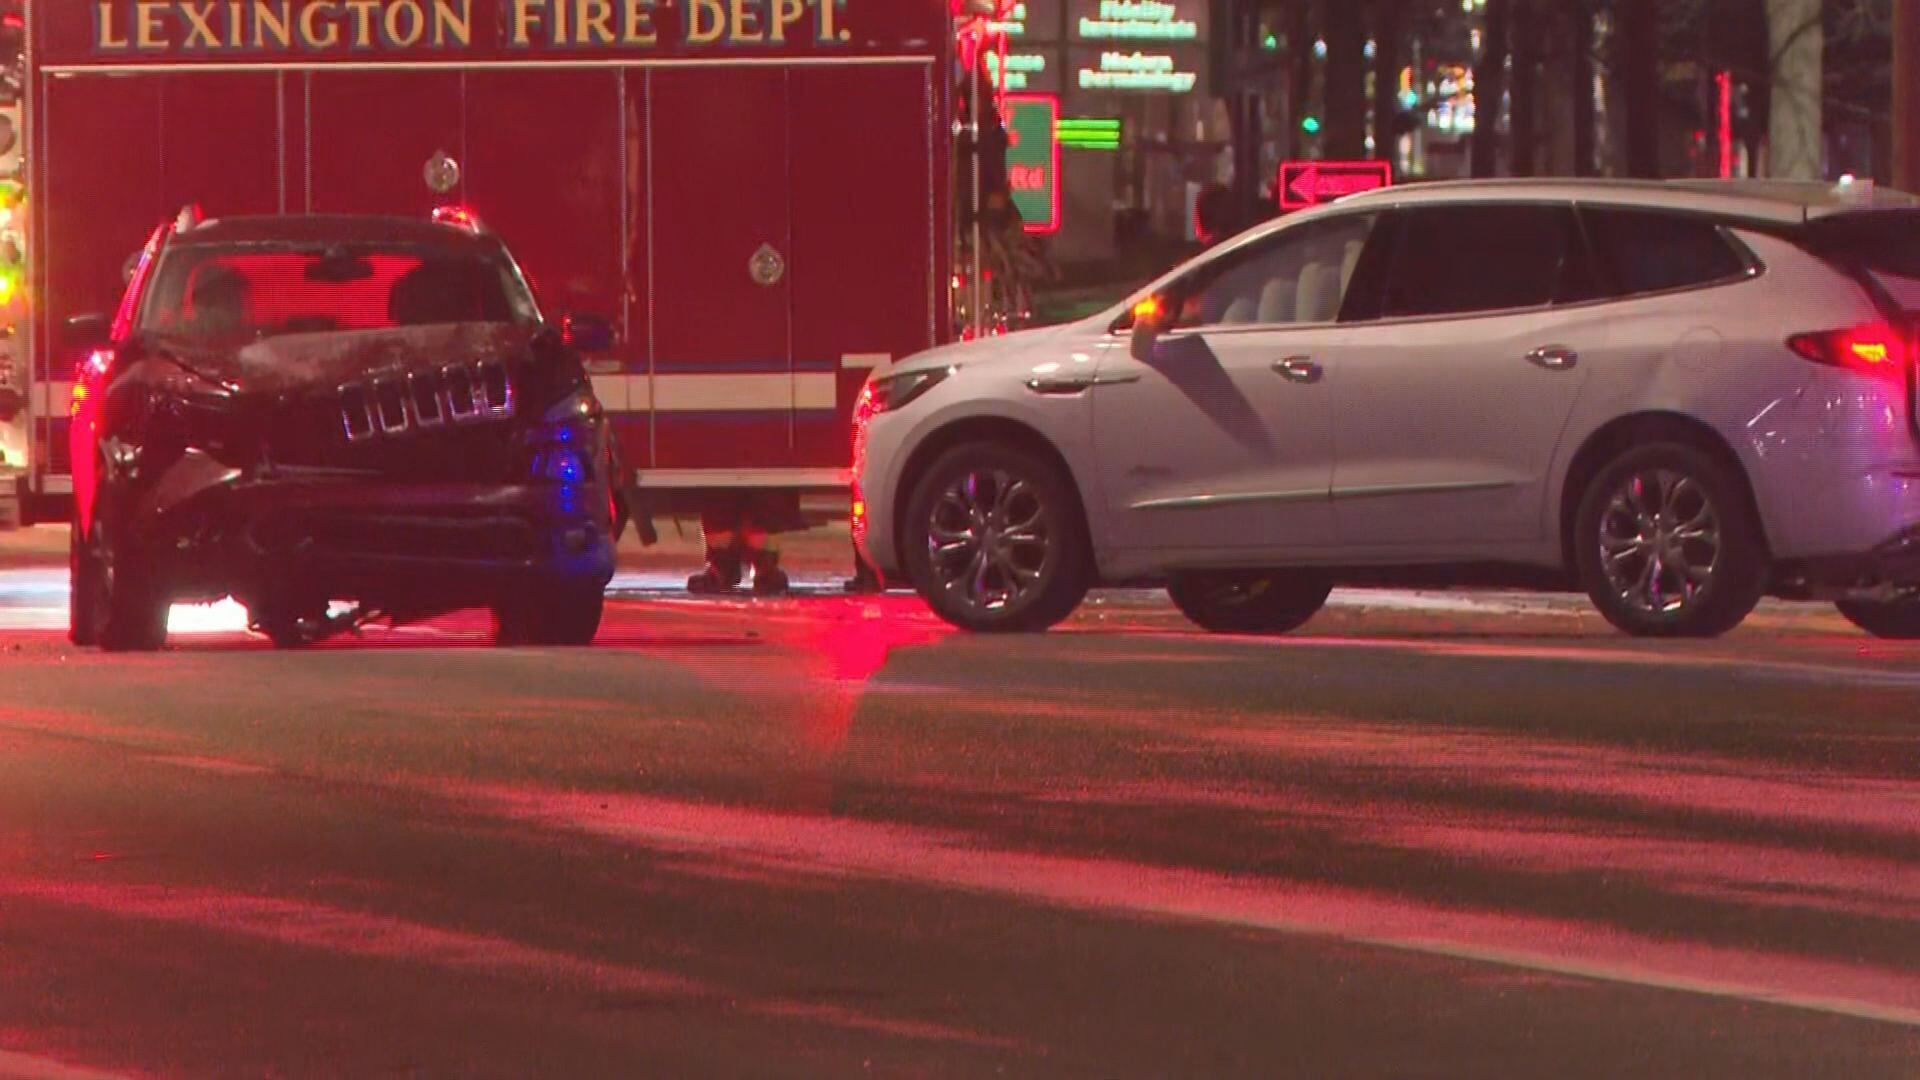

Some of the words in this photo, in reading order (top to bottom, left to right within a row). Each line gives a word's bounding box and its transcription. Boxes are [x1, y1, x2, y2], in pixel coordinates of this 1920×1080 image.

[100, 0, 471, 48] LEXINGTON
[513, 0, 657, 43] FIRE
[687, 0, 852, 42] DEPT.
